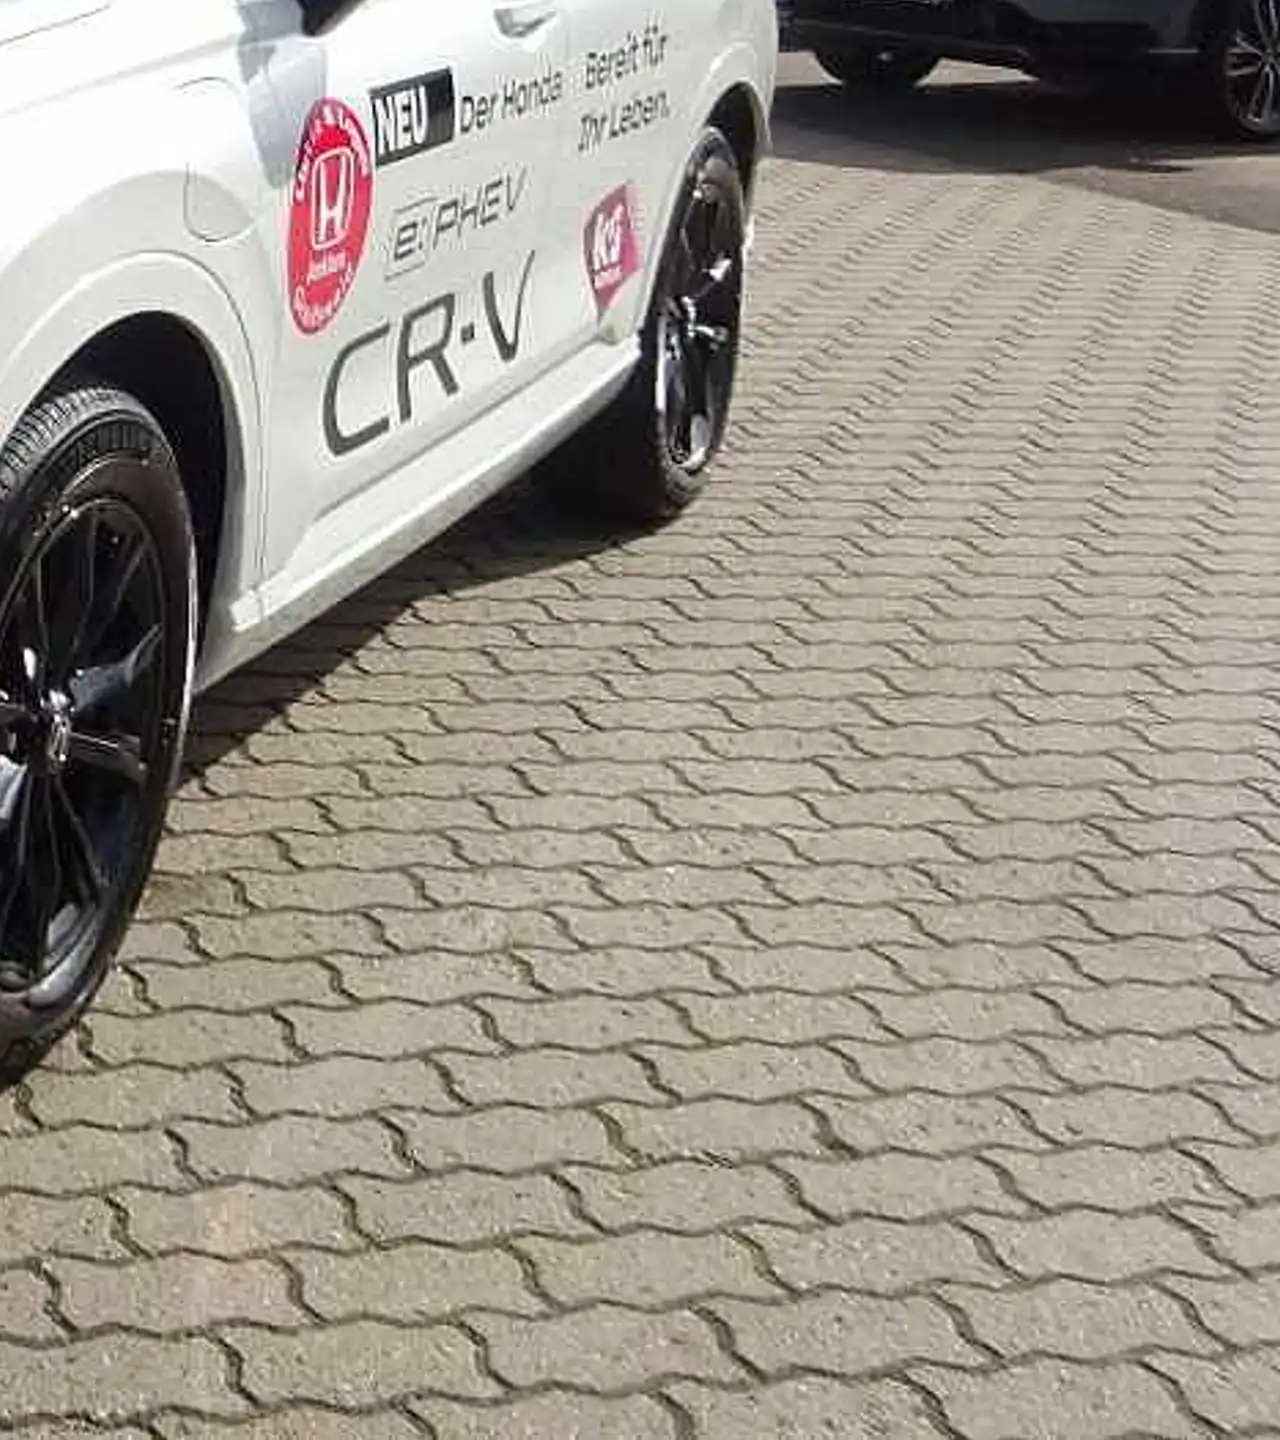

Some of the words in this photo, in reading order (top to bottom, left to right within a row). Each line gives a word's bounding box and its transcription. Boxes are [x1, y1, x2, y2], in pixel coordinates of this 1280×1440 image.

[585, 32, 638, 90] Bereit
[642, 24, 668, 68] für
[375, 84, 430, 157] NEU
[459, 91, 499, 135] Der
[502, 64, 564, 120] Honda
[578, 114, 608, 153] Ihr
[321, 249, 536, 457] CR-V
